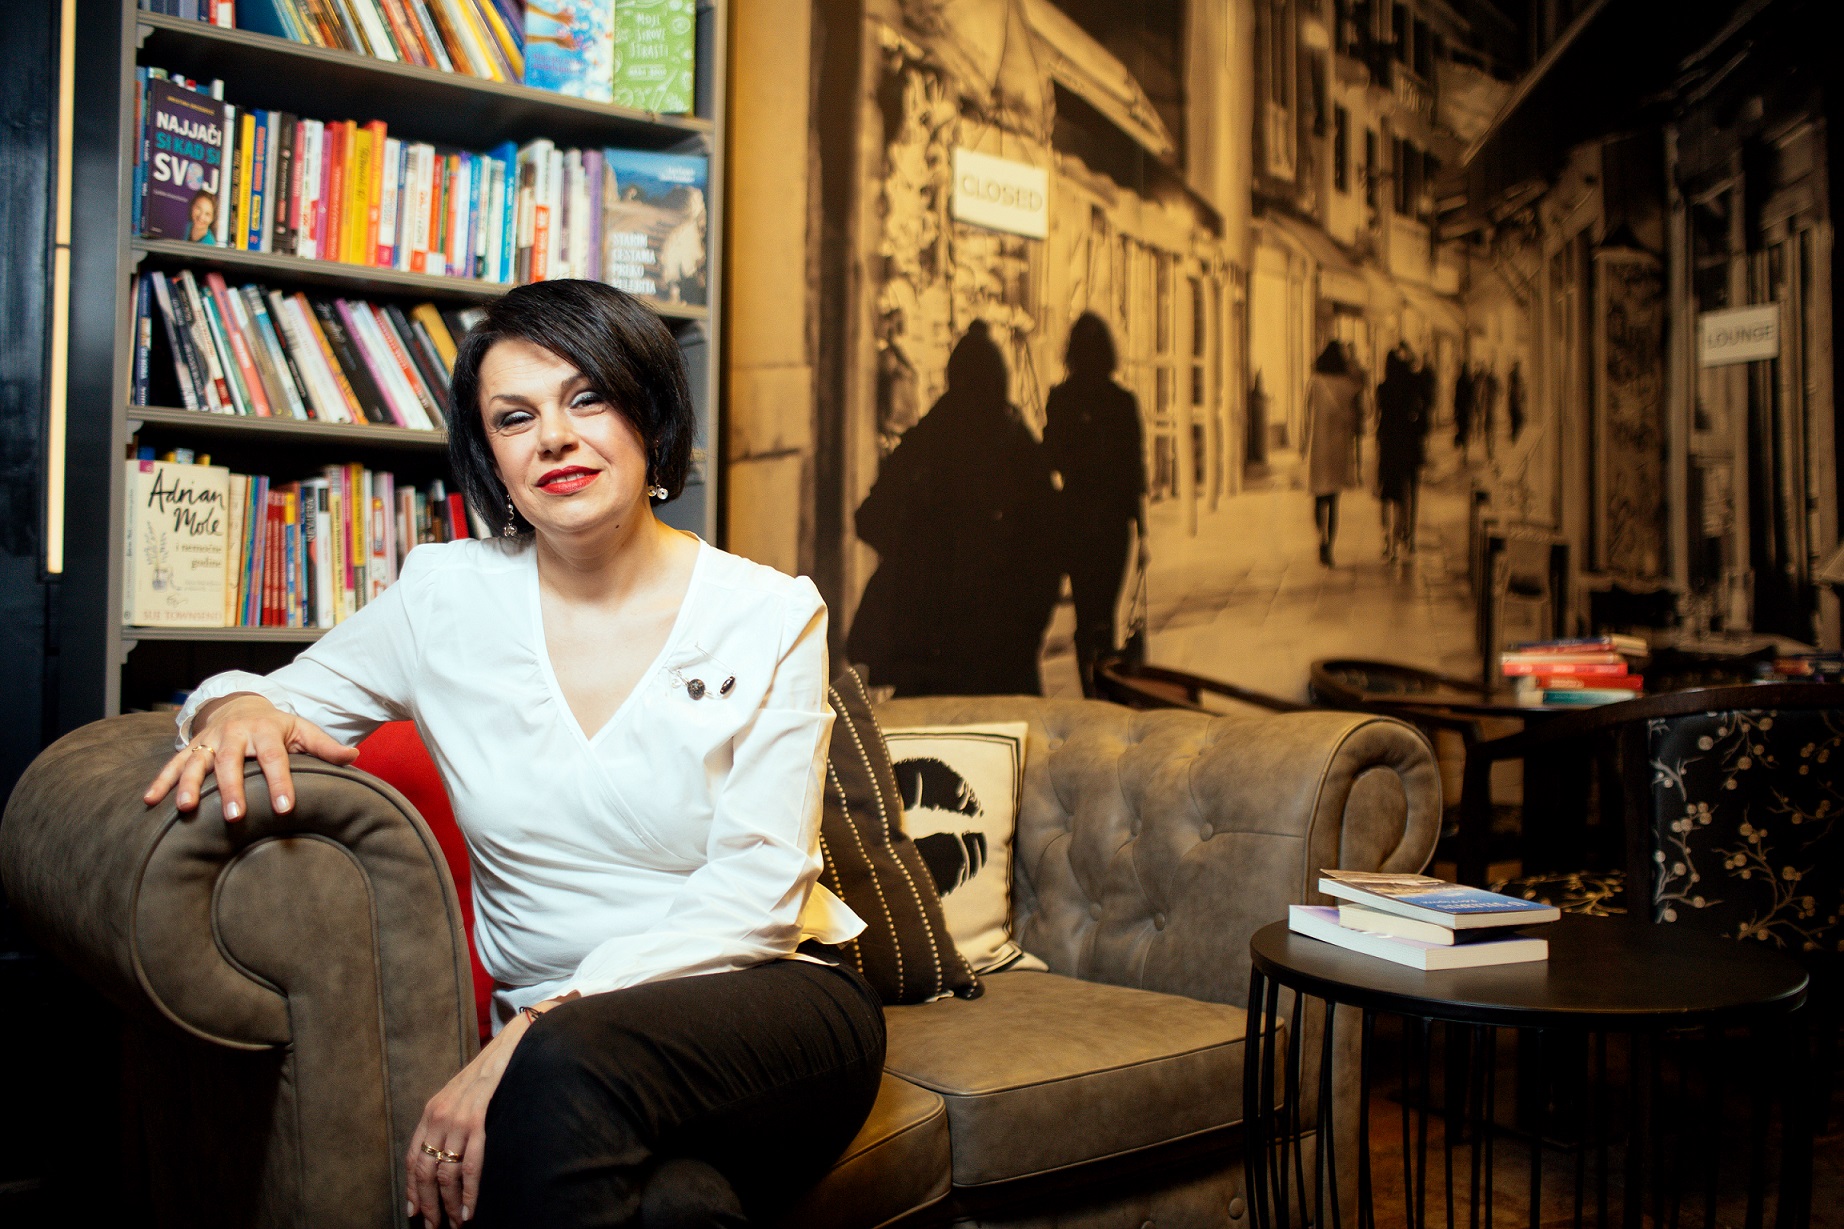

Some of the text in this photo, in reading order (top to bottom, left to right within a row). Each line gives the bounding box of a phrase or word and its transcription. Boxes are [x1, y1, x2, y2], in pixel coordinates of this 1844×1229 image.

[156, 110, 222, 147] NAJJAČI
[155, 131, 221, 166] SI KAD SI
[153, 151, 220, 195] SVOJ
[962, 174, 1043, 212] CLOSED
[611, 248, 656, 265] CESTAMA
[611, 263, 645, 279] PREKO
[1707, 321, 1775, 349] LOUNGE
[148, 468, 225, 513] Adrian
[173, 507, 223, 537] Mole
